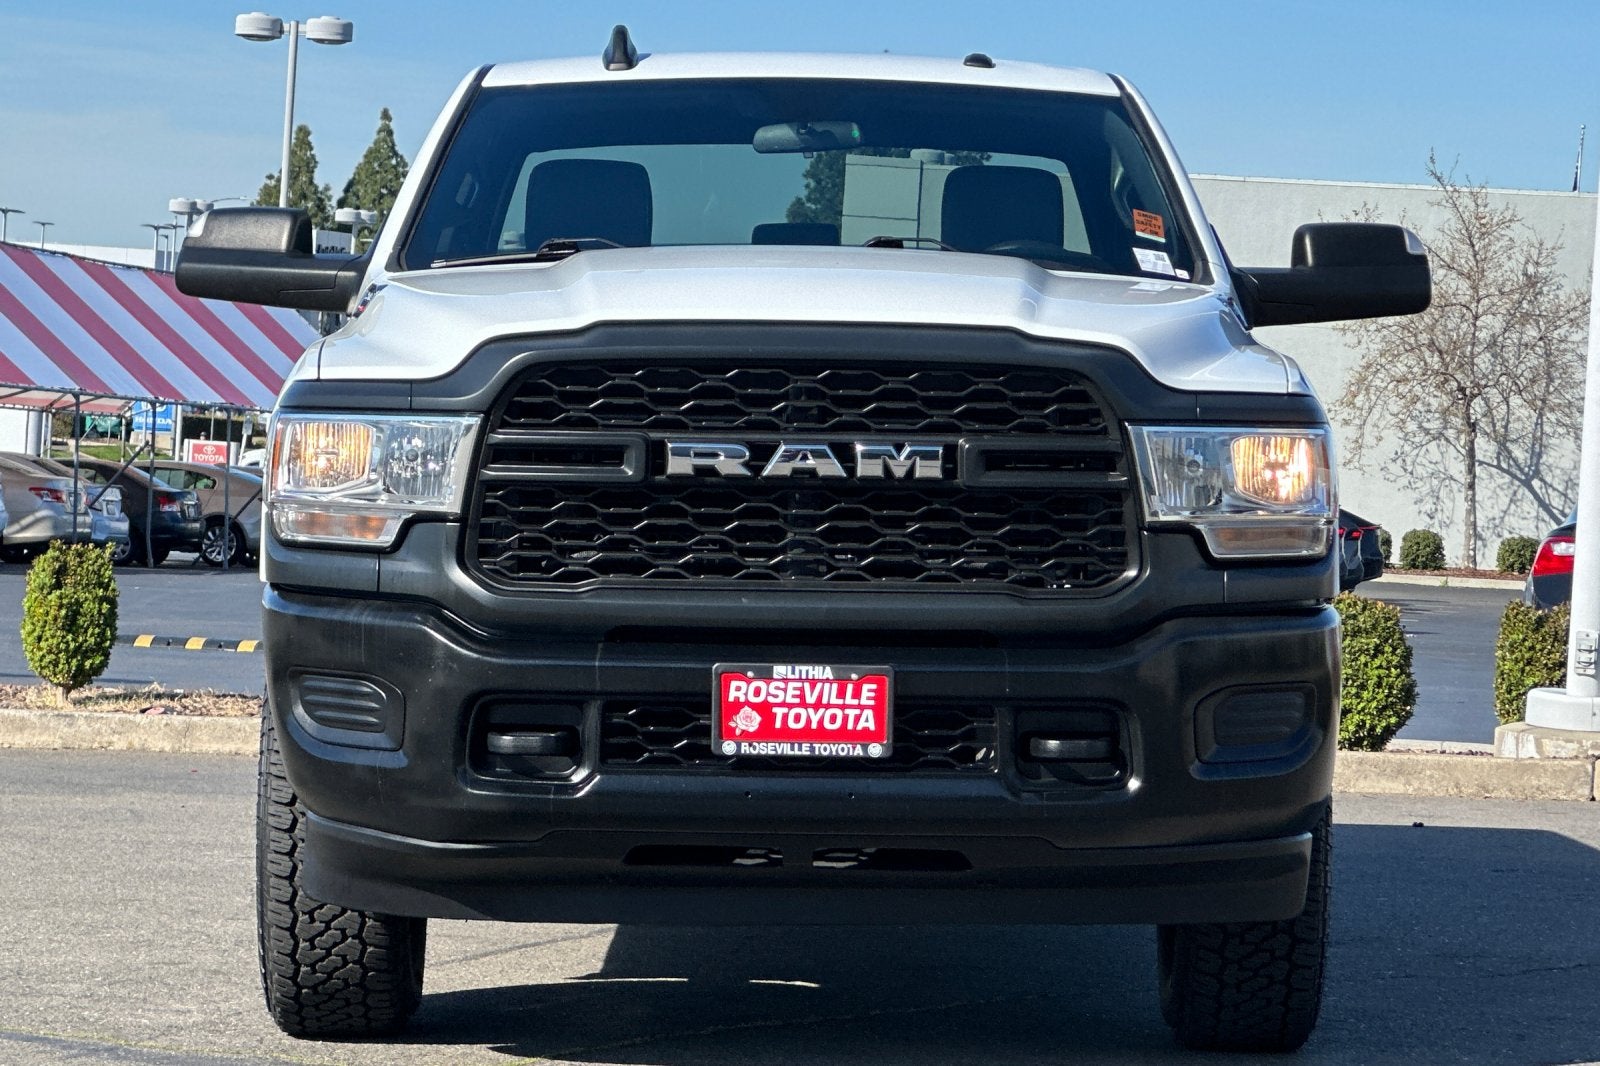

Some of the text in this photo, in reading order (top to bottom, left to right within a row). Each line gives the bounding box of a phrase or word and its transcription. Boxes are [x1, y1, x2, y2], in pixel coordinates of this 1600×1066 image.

[135, 416, 172, 424] HODA
[194, 454, 225, 463] TOYOTA
[665, 440, 944, 478] RAM
[787, 666, 834, 680] LITHIA
[728, 680, 877, 705] ROSEVILLE
[772, 707, 876, 731] TOYOTA
[741, 743, 863, 756] ROSEVILLE TOYOTA
